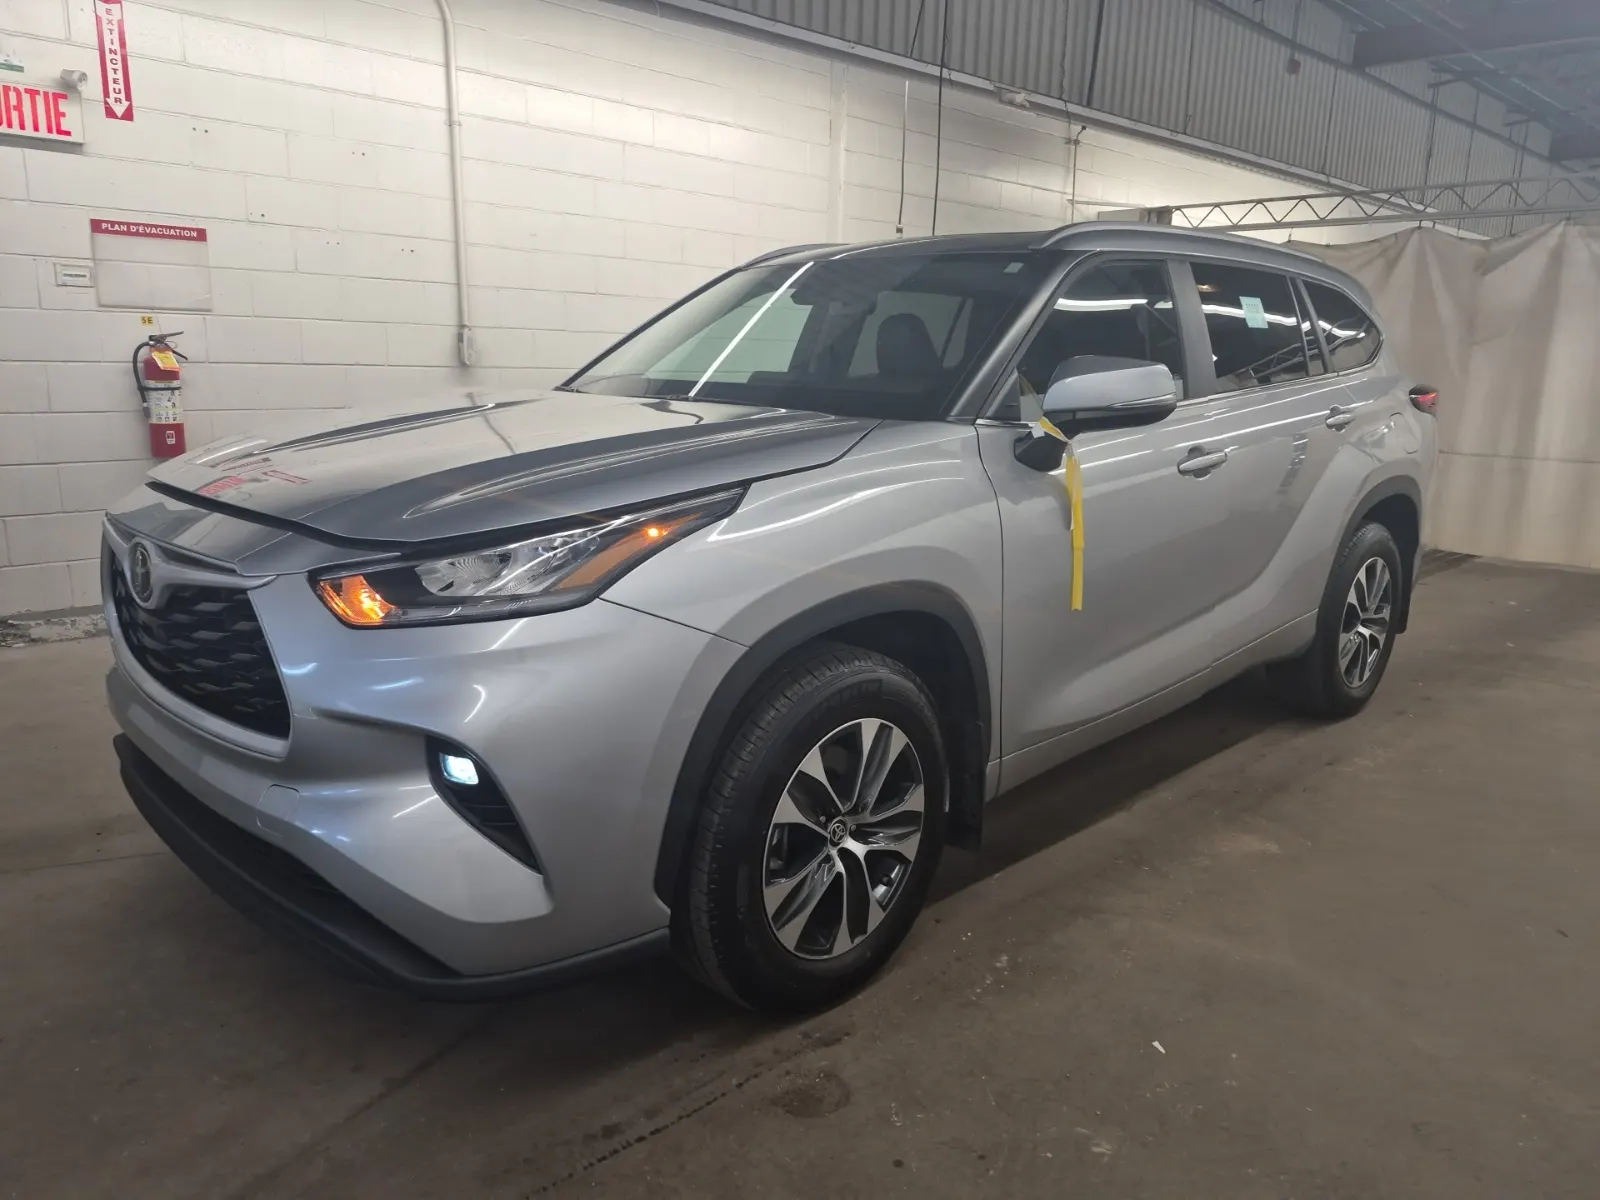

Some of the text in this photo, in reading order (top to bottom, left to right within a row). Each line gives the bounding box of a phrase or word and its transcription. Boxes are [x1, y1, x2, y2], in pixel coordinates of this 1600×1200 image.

[105, 8, 122, 104] EXTINCTEUR
[0, 85, 72, 136] RTIE
[101, 223, 197, 237] PLAN D'ÉVACUATION
